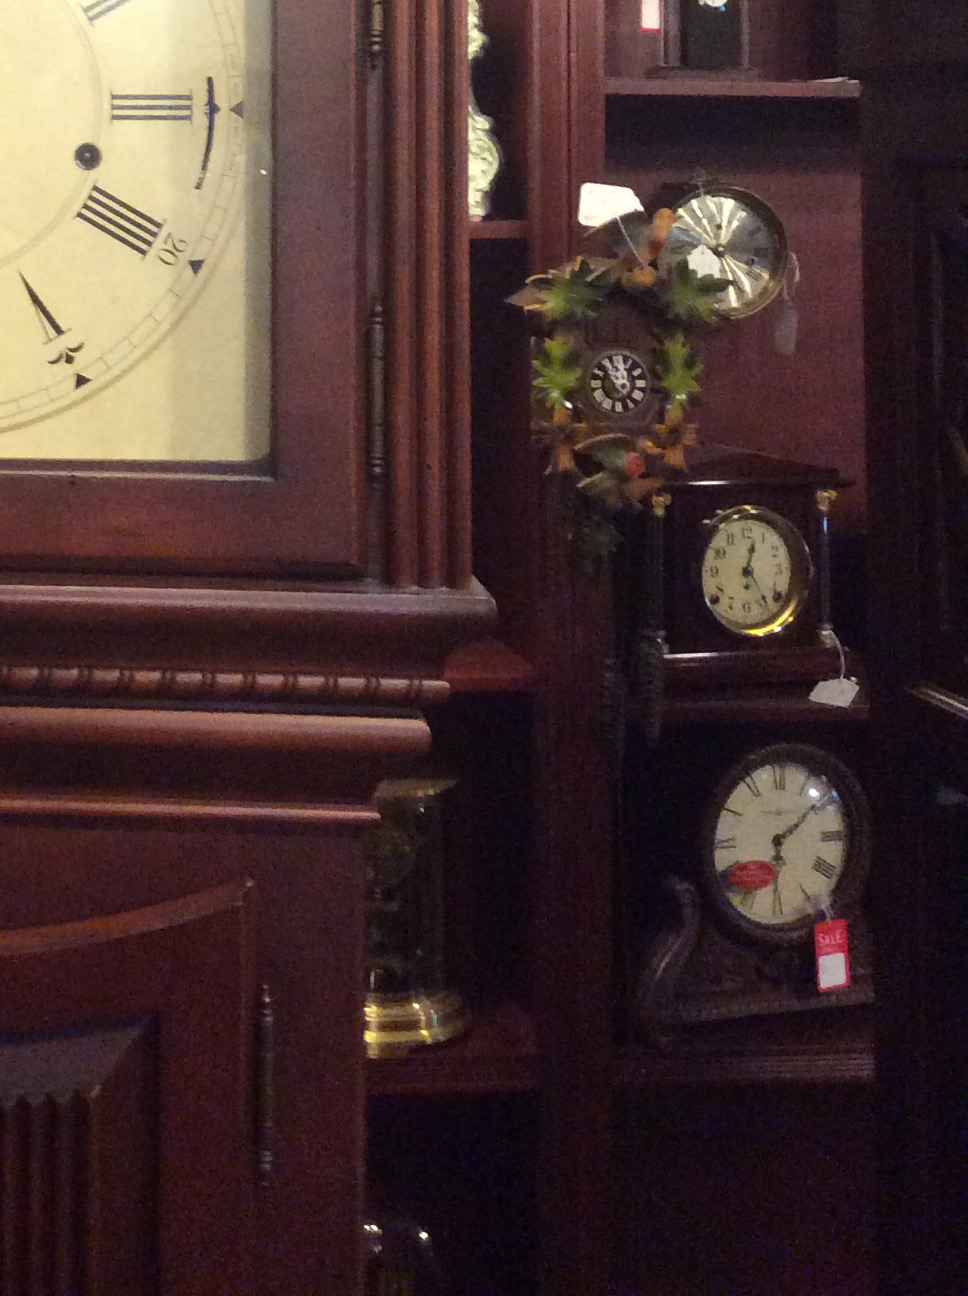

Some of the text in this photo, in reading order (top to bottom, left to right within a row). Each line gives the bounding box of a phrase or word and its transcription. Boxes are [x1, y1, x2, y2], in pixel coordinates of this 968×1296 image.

[109, 88, 193, 124] III
[157, 232, 189, 267] 20
[18, 270, 72, 345] V
